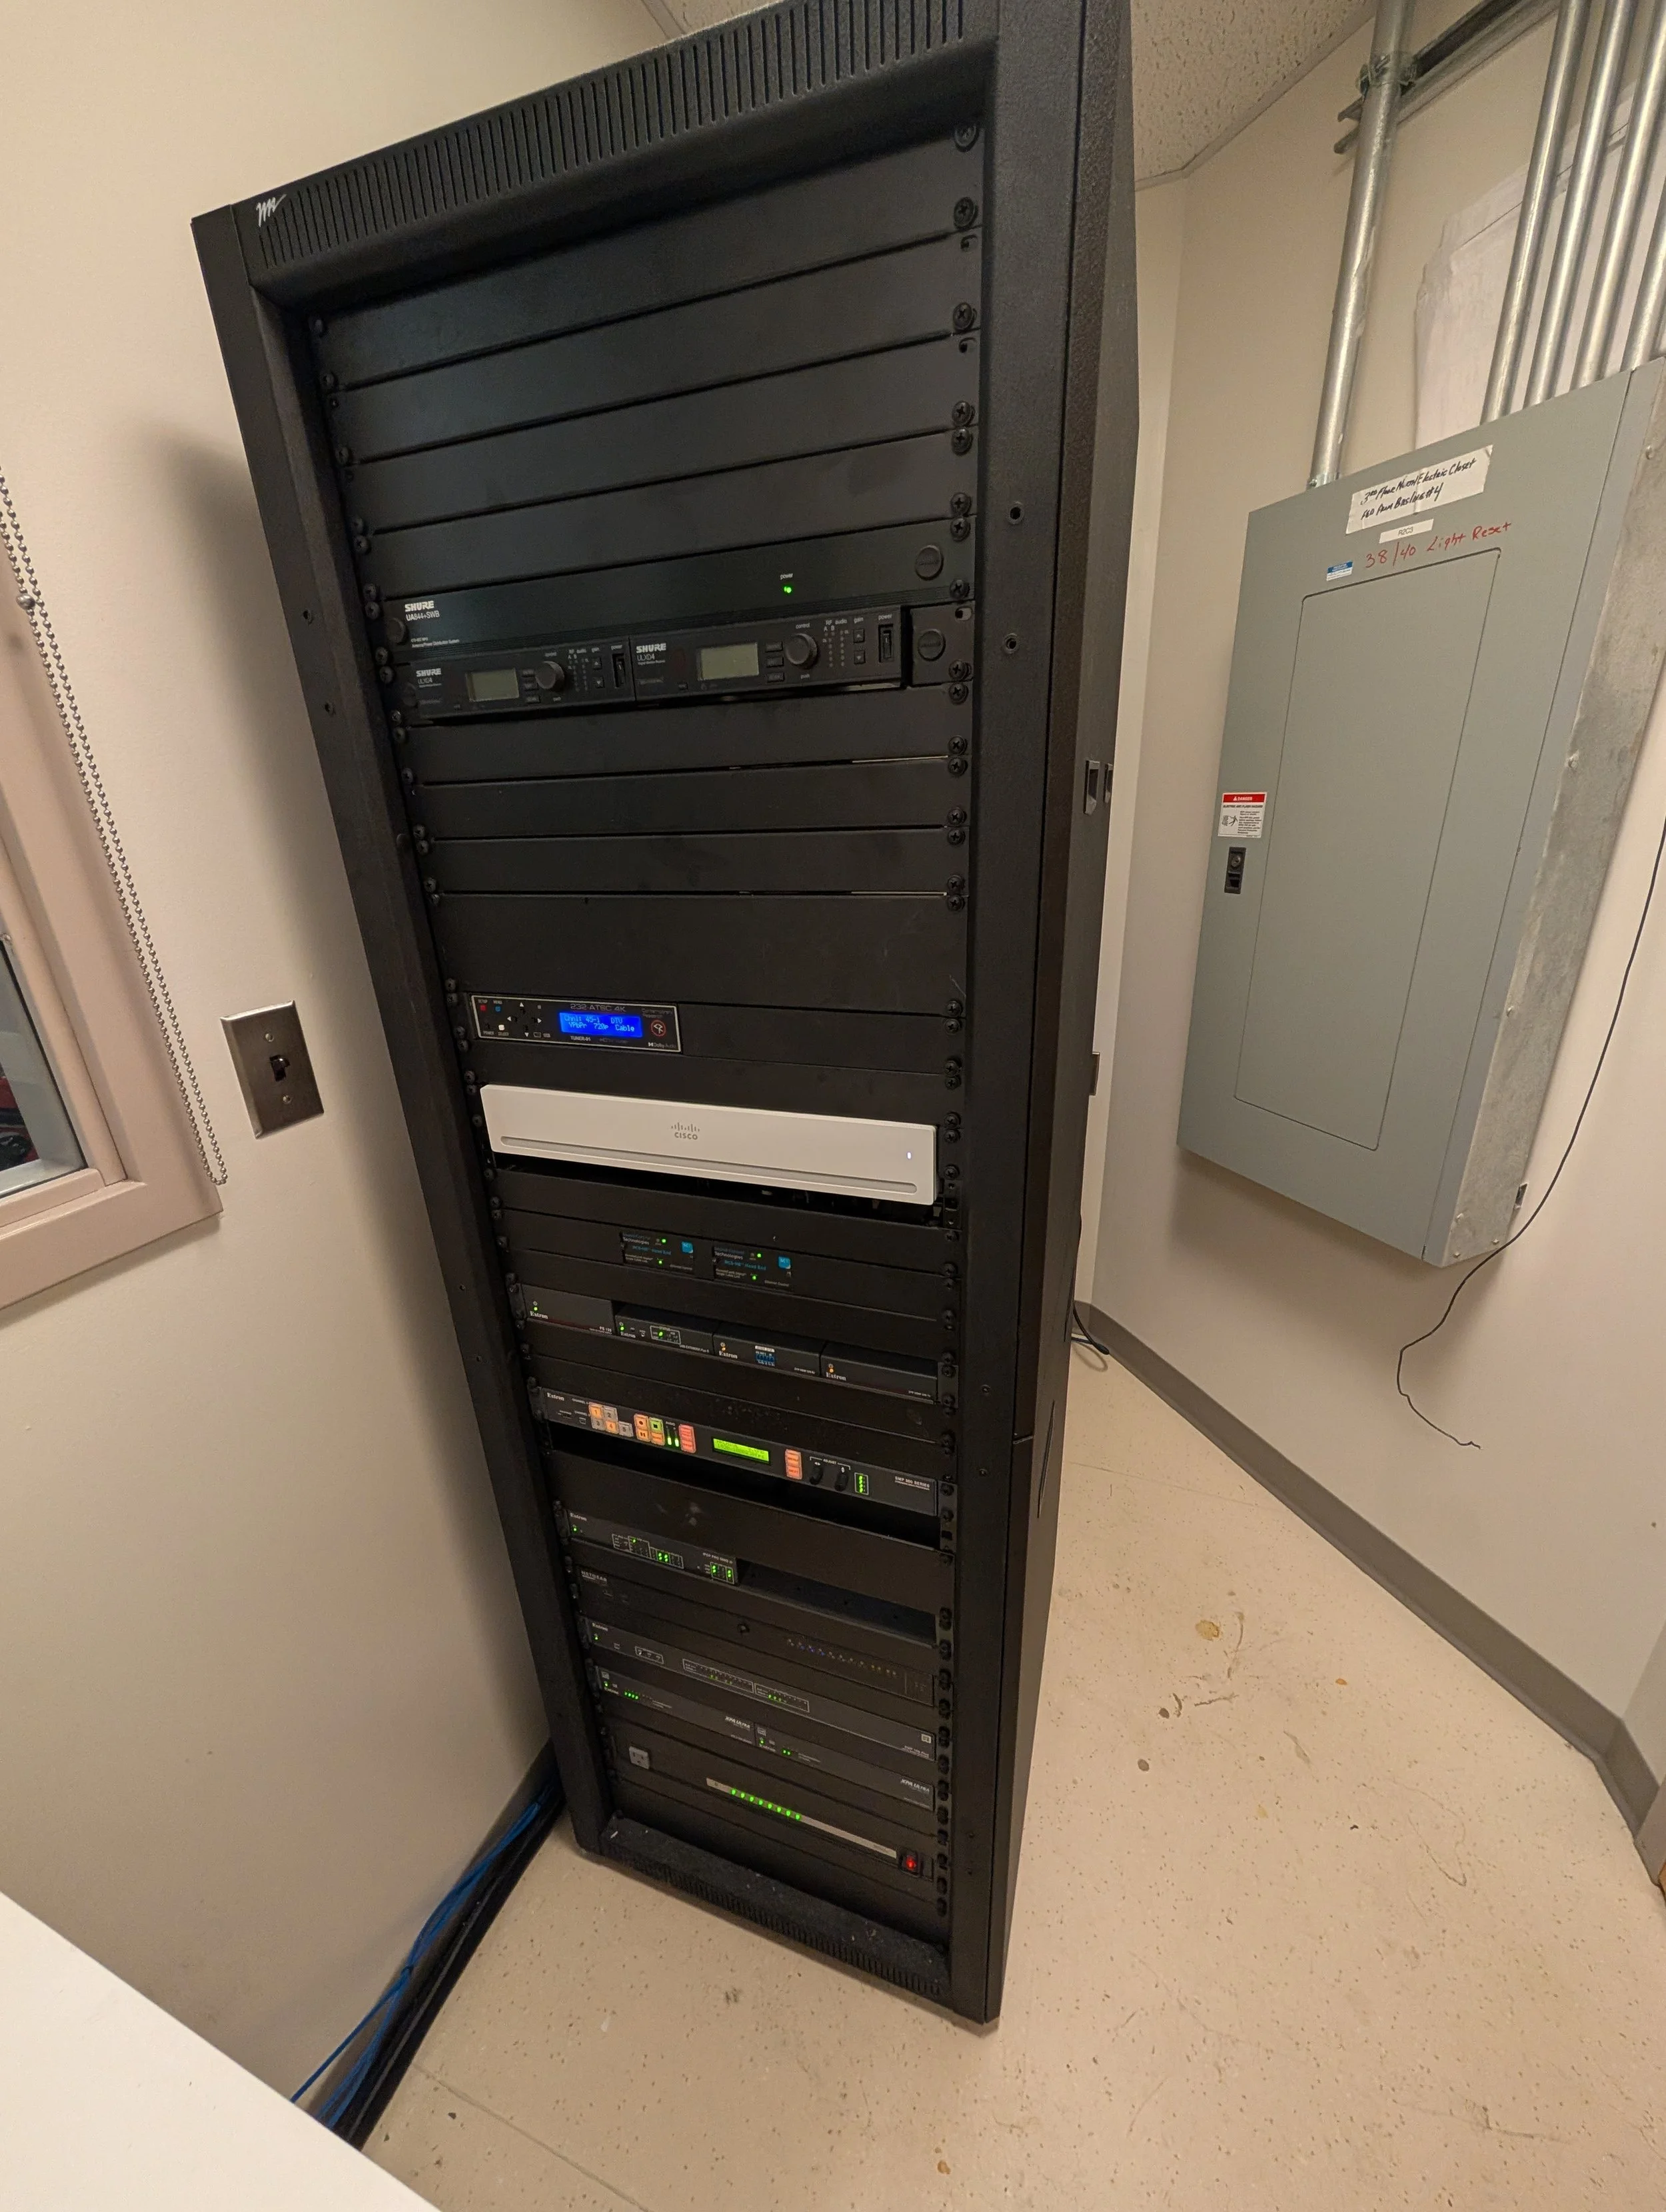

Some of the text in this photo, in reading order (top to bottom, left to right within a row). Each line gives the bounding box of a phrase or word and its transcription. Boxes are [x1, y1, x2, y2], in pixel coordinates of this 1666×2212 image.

[1417, 468, 1447, 485] Electric
[1448, 458, 1477, 475] Closet
[1364, 522, 1511, 568] 38/40 Light Reset
[405, 600, 434, 612] SHURE
[405, 610, 440, 621] UA844+SWB
[636, 642, 666, 654] SHURE
[416, 668, 442, 678] SHURE
[530, 1311, 548, 1319] Extron
[719, 1351, 738, 1359] Extron
[826, 1373, 846, 1381] Extron
